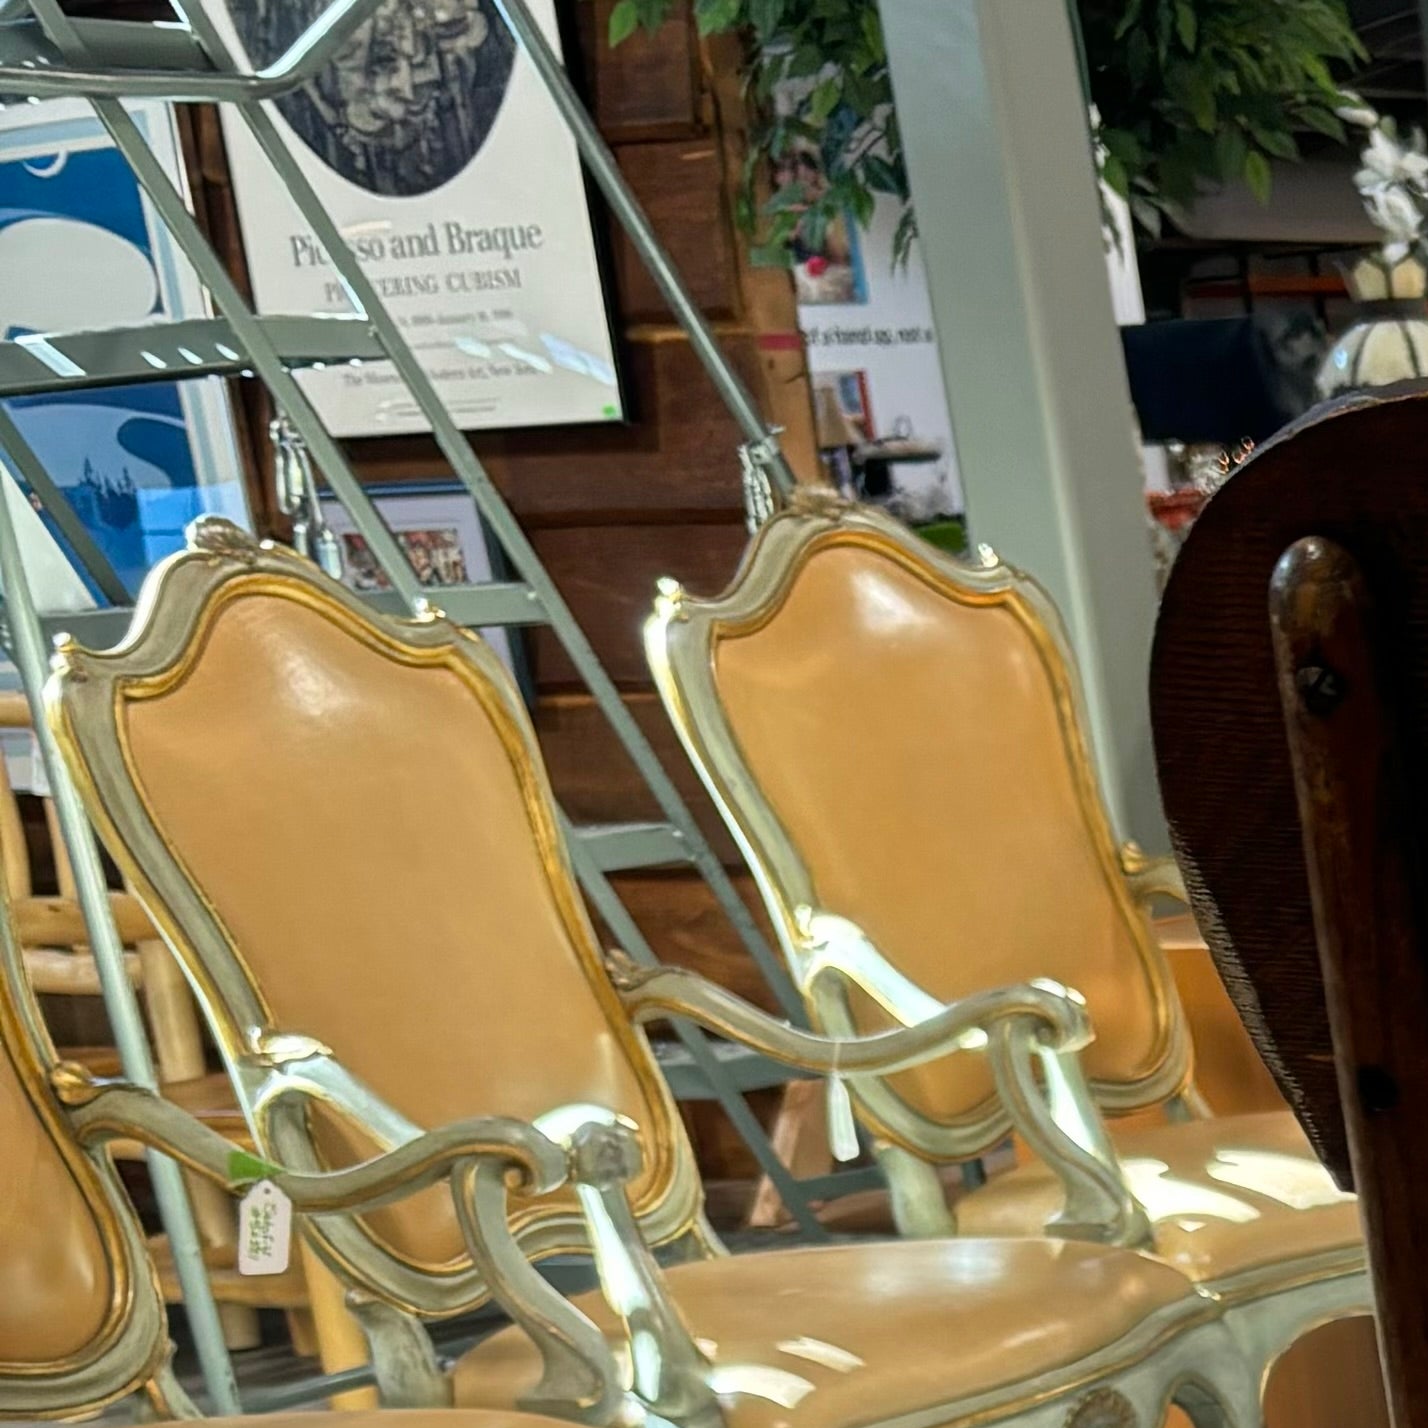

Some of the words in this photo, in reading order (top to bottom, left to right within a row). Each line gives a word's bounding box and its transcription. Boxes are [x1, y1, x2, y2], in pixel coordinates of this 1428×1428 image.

[290, 233, 386, 267] Picso
[389, 222, 440, 260] and
[445, 221, 546, 259] Braque
[446, 269, 522, 294] CUBISM
